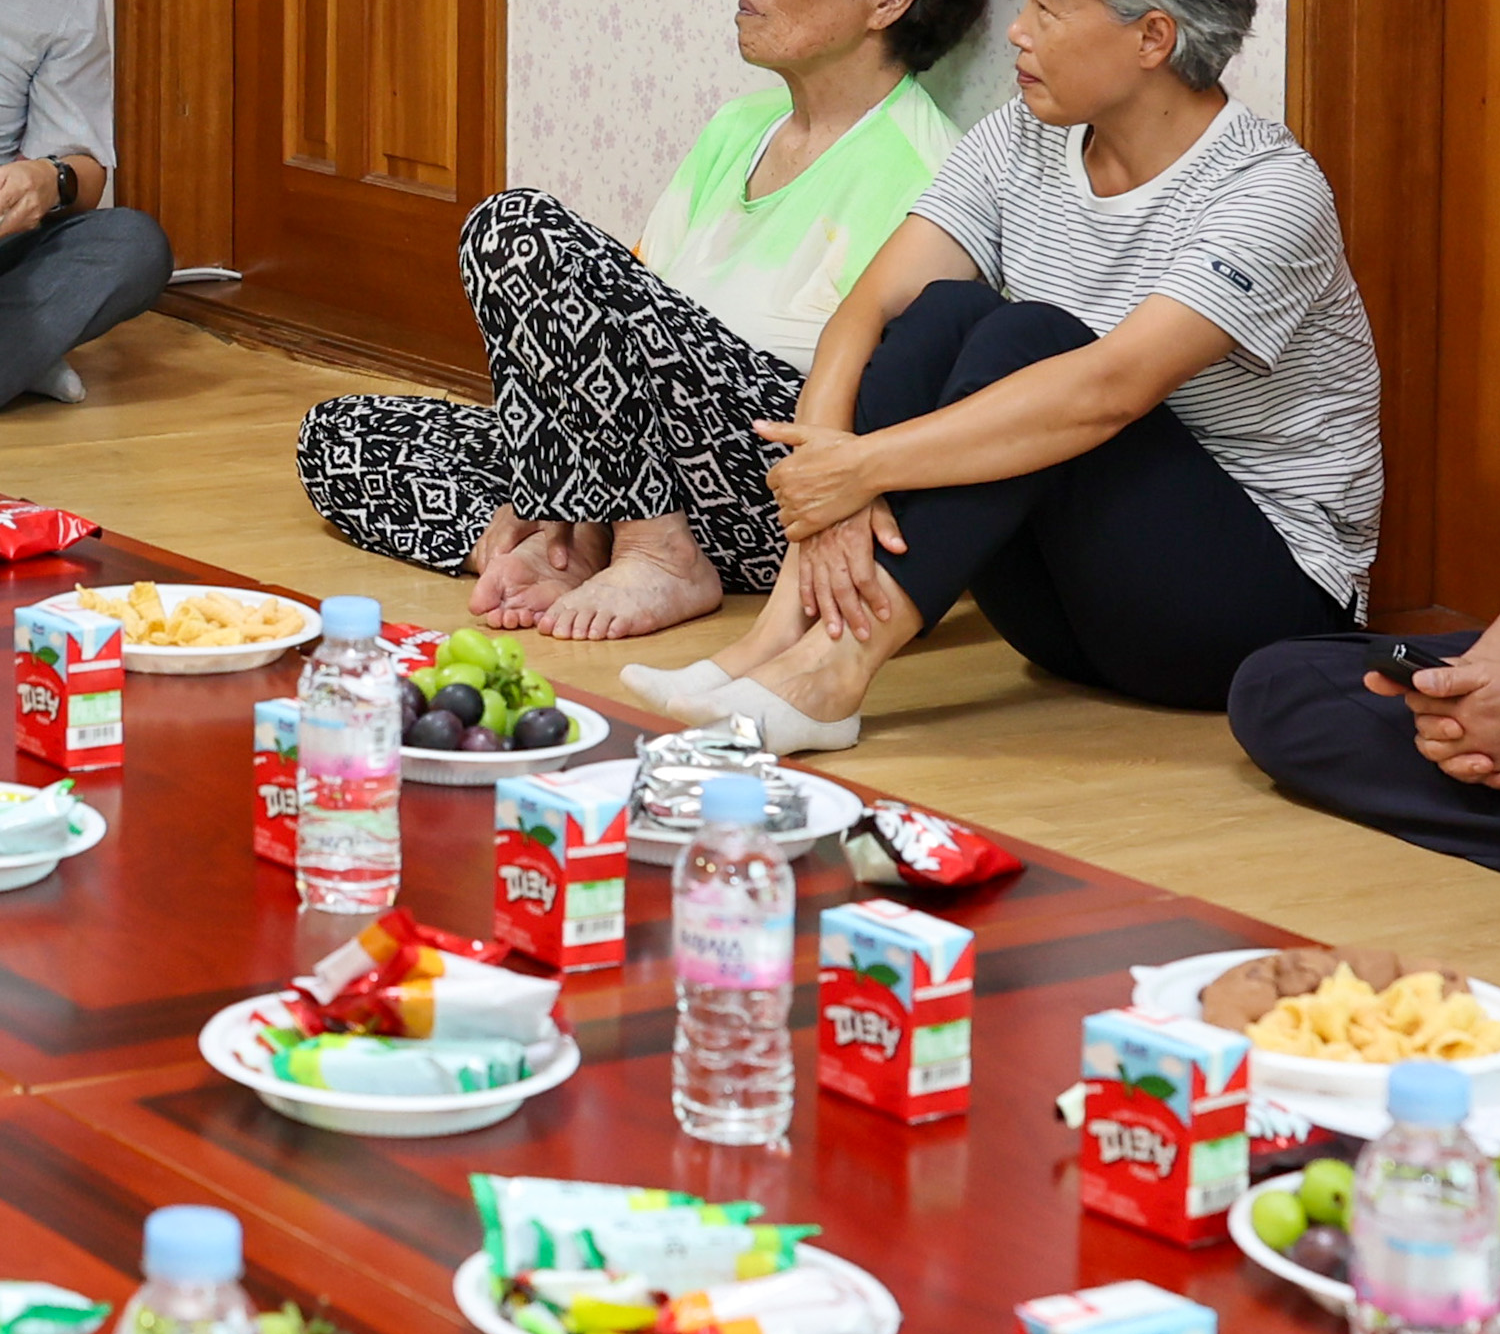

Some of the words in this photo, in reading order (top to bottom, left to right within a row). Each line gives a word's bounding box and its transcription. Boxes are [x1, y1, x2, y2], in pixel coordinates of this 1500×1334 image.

[17, 683, 60, 721] 피크닉
[499, 864, 557, 912] 피크닉
[824, 1005, 901, 1059] 피크닉
[1088, 1119, 1178, 1178] 피크닉
